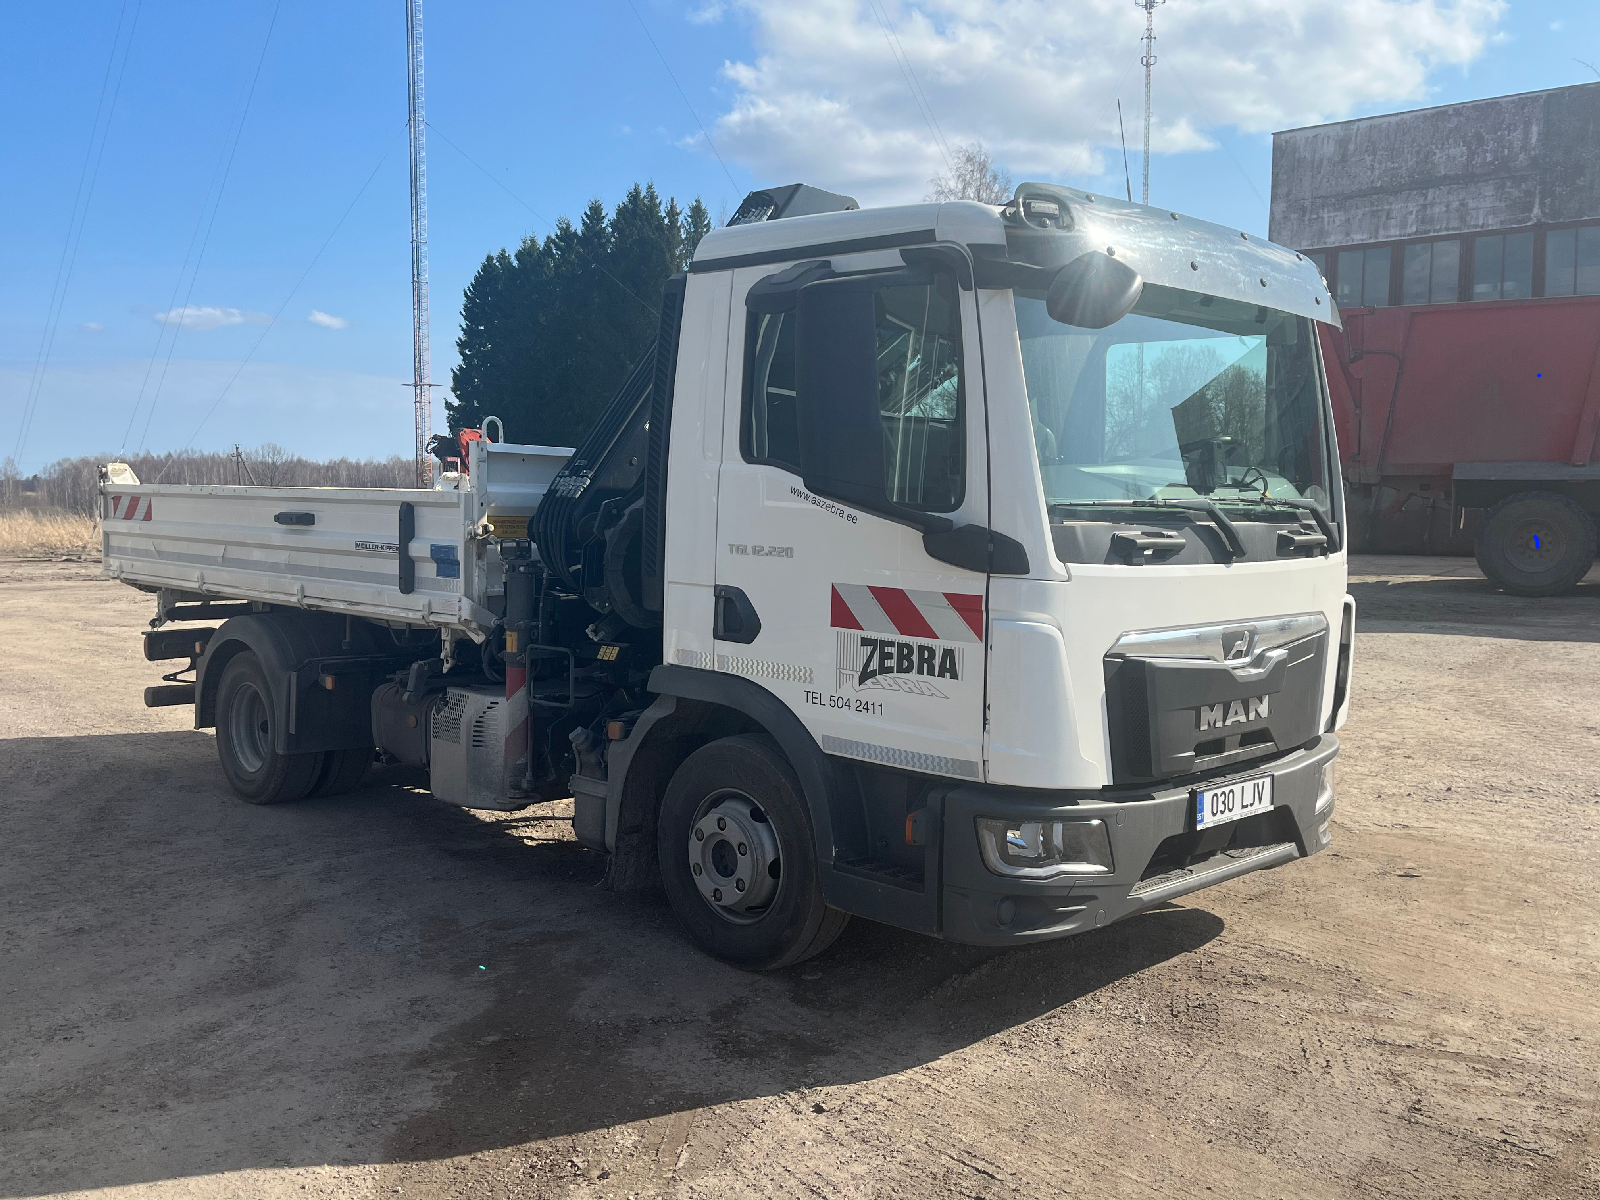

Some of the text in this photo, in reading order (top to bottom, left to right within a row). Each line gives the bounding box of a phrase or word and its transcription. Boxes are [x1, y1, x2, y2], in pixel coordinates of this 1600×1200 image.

[790, 485, 858, 524] www.aszebra.ee
[728, 543, 794, 558] TGL 12.220
[859, 636, 959, 687] ZEBRA
[803, 690, 884, 716] TEL 504 2411
[1200, 694, 1269, 731] MAN
[1211, 780, 1265, 817] 030 LJV
